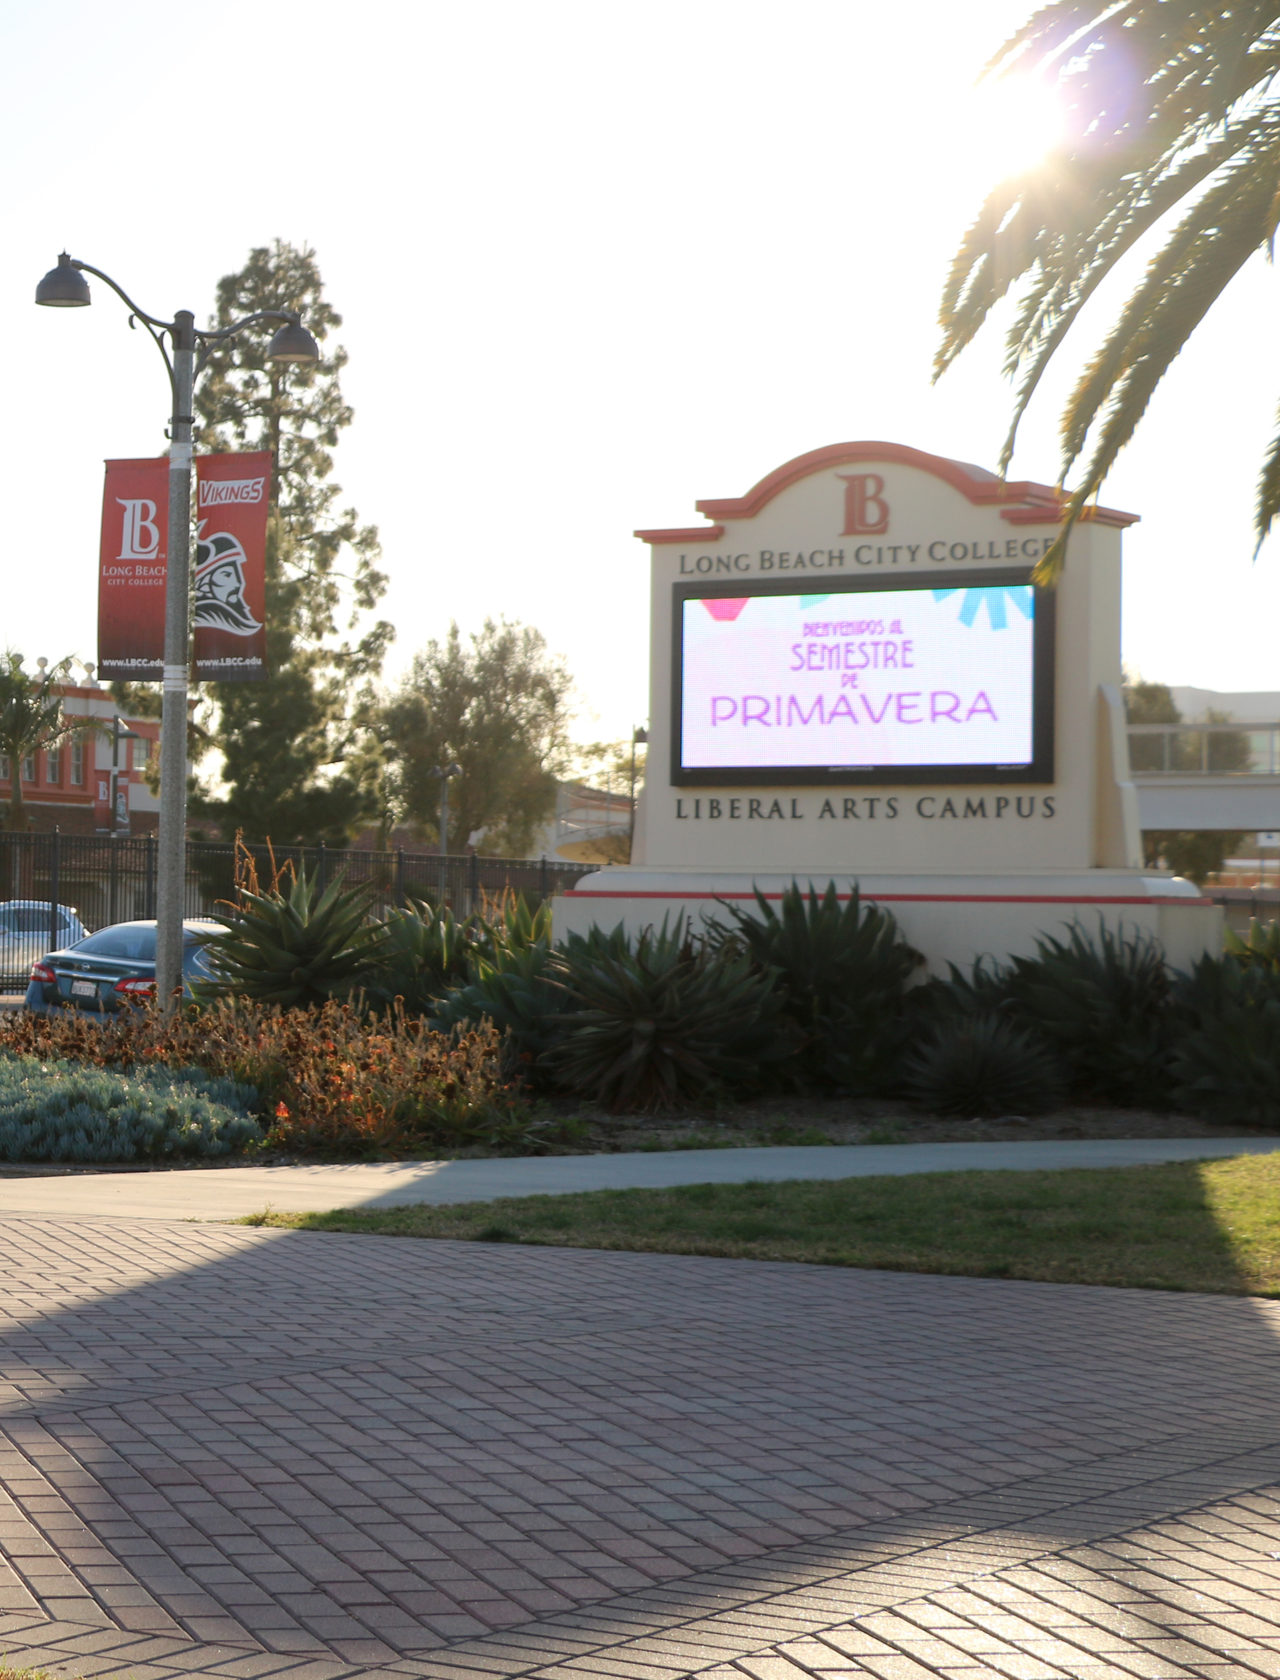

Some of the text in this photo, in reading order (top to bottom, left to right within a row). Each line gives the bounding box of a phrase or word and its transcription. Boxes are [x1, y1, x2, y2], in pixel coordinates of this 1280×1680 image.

[200, 477, 264, 506] VIKINGS
[102, 565, 133, 577] LONG
[679, 553, 751, 575] LONG
[758, 549, 845, 571] BEACH
[854, 544, 920, 566] CITY
[107, 578, 163, 586] CITY COLLEGE
[196, 656, 263, 667] www.LBCC.edu
[790, 640, 915, 671] SEMESTRE
[711, 690, 999, 727] PRIMAVERA
[676, 796, 1056, 820] LIBERAL ARTS CAMPUS
